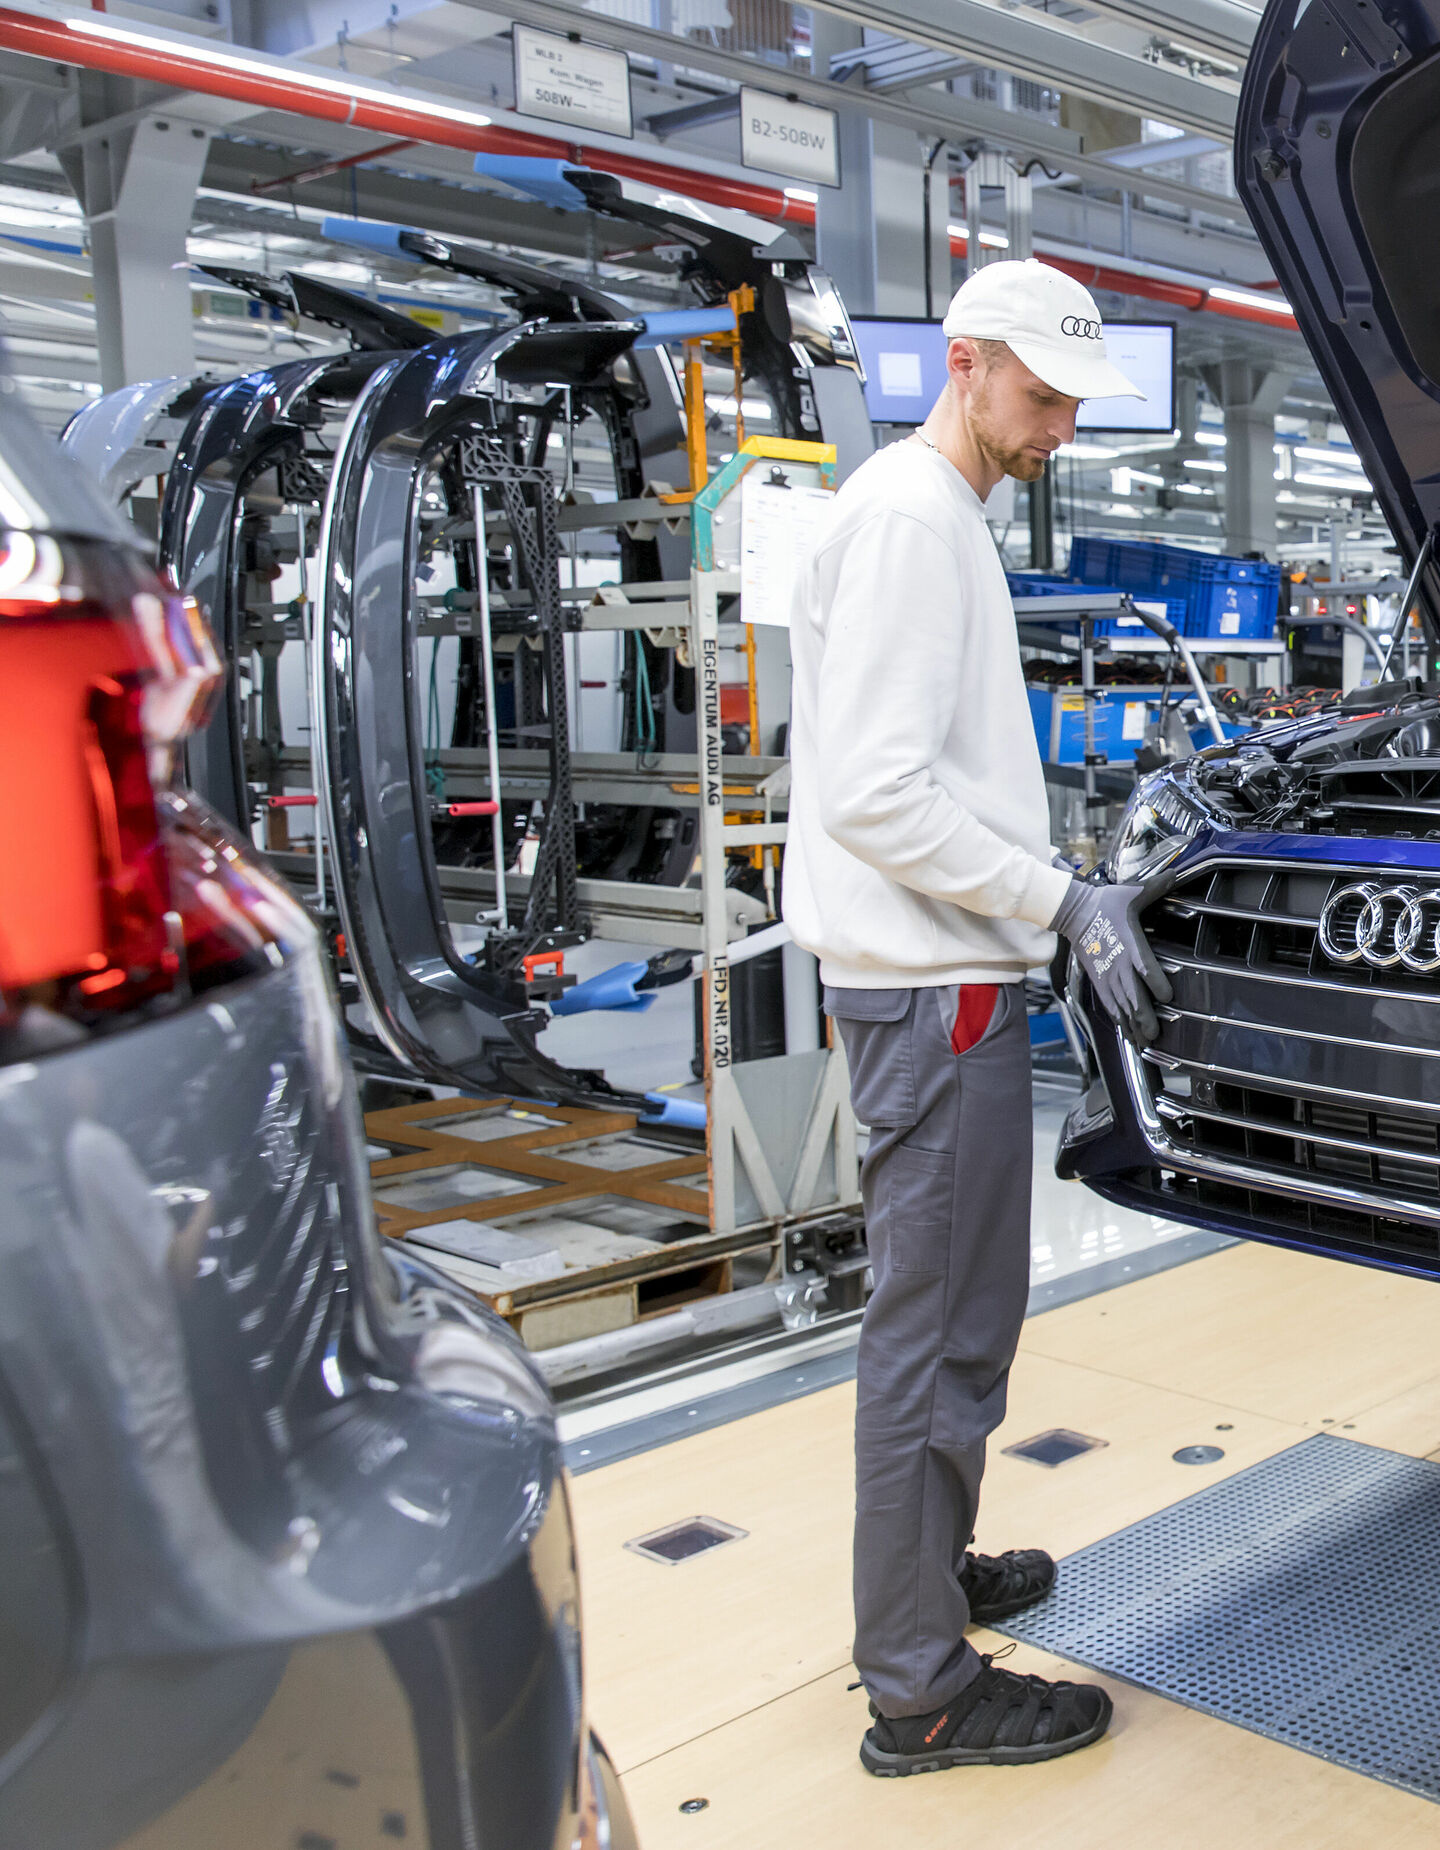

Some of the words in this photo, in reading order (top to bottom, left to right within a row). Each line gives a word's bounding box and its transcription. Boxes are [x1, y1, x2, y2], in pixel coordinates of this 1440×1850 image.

[751, 118, 826, 150] B2-508W
[703, 639, 718, 729] EIGENTUM
[706, 734, 719, 775] AUDI
[708, 780, 721, 806] AG
